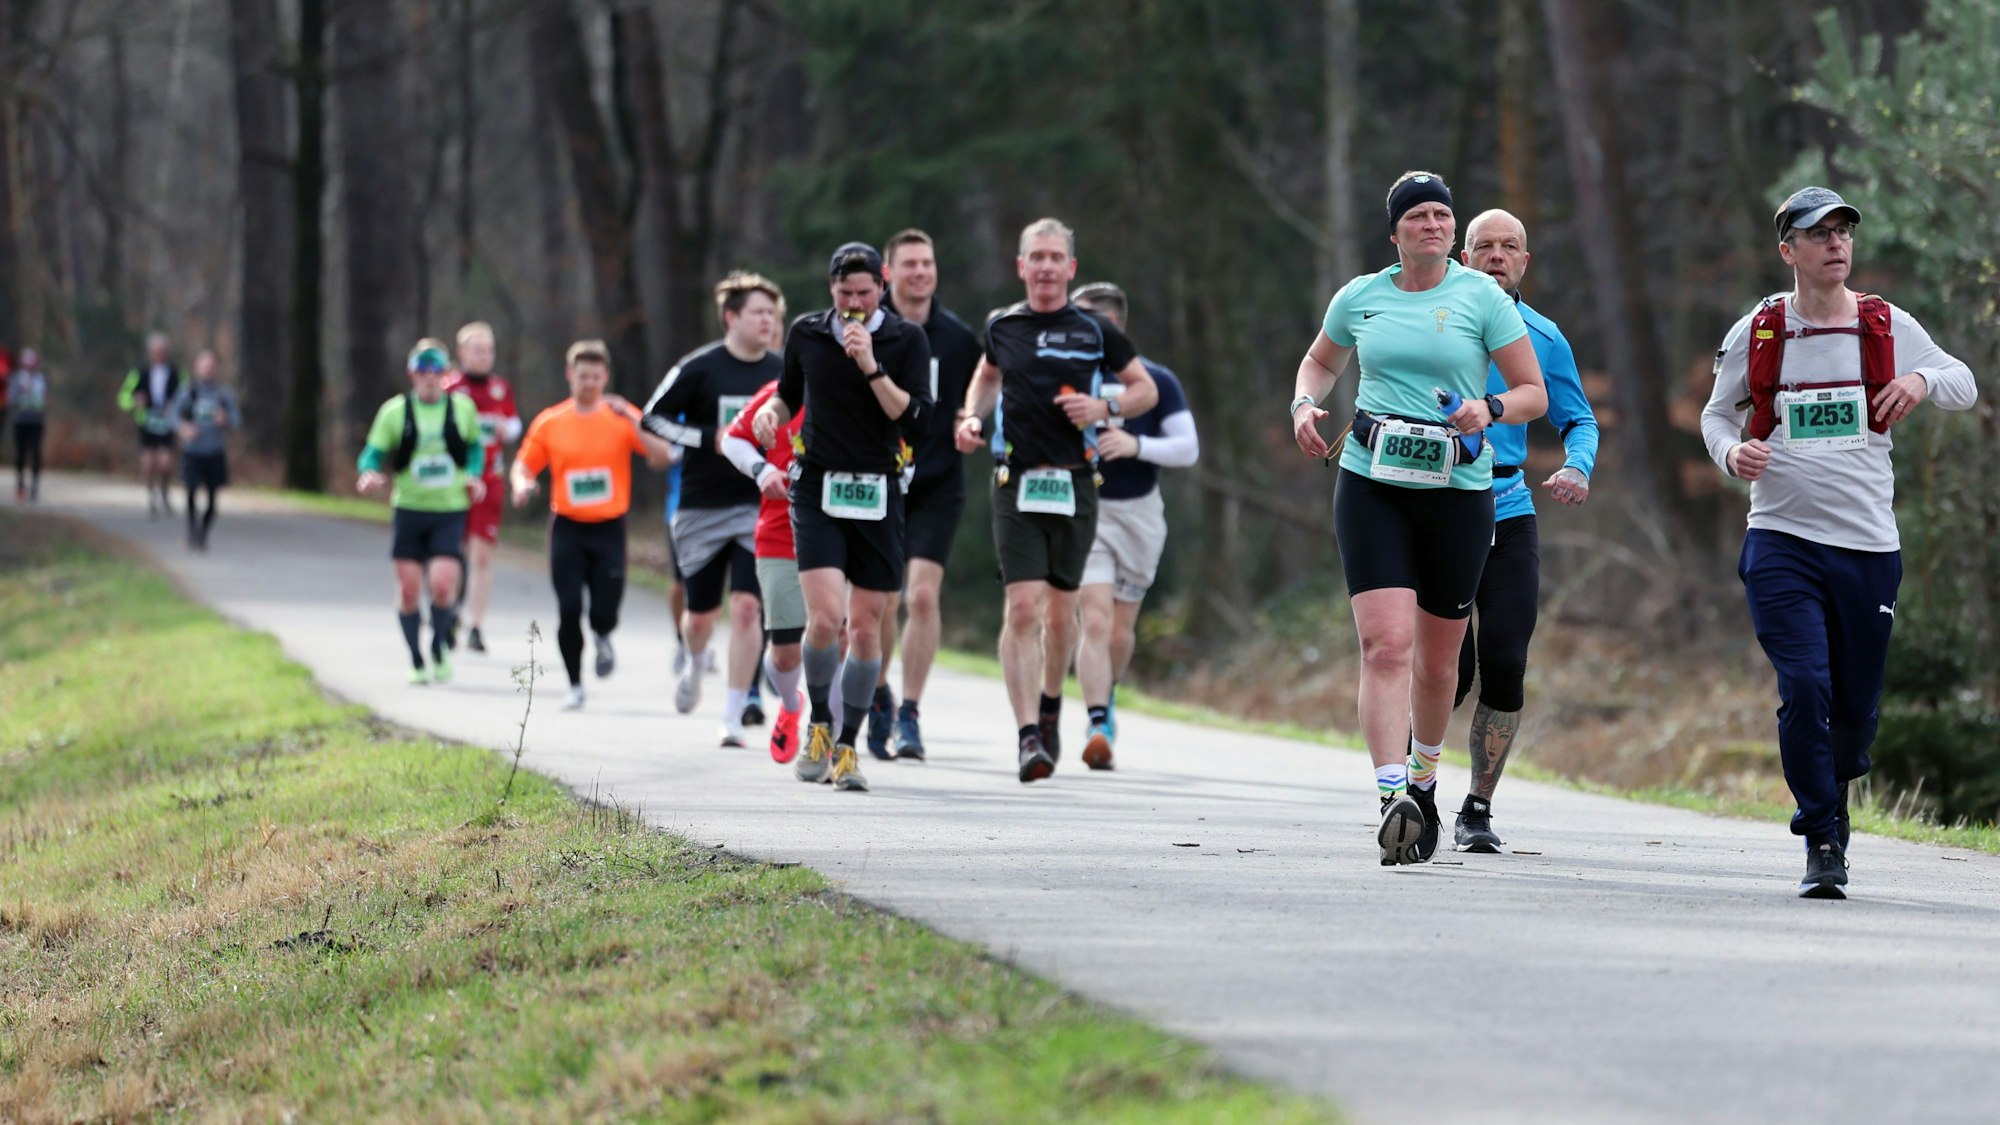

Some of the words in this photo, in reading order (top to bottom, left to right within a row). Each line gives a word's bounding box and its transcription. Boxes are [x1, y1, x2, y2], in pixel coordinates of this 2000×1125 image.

[1794, 403, 1854, 427] 1253
[1385, 436, 1441, 462] 8823
[834, 482, 876, 501] 1567
[1028, 479, 1069, 497] 2404
